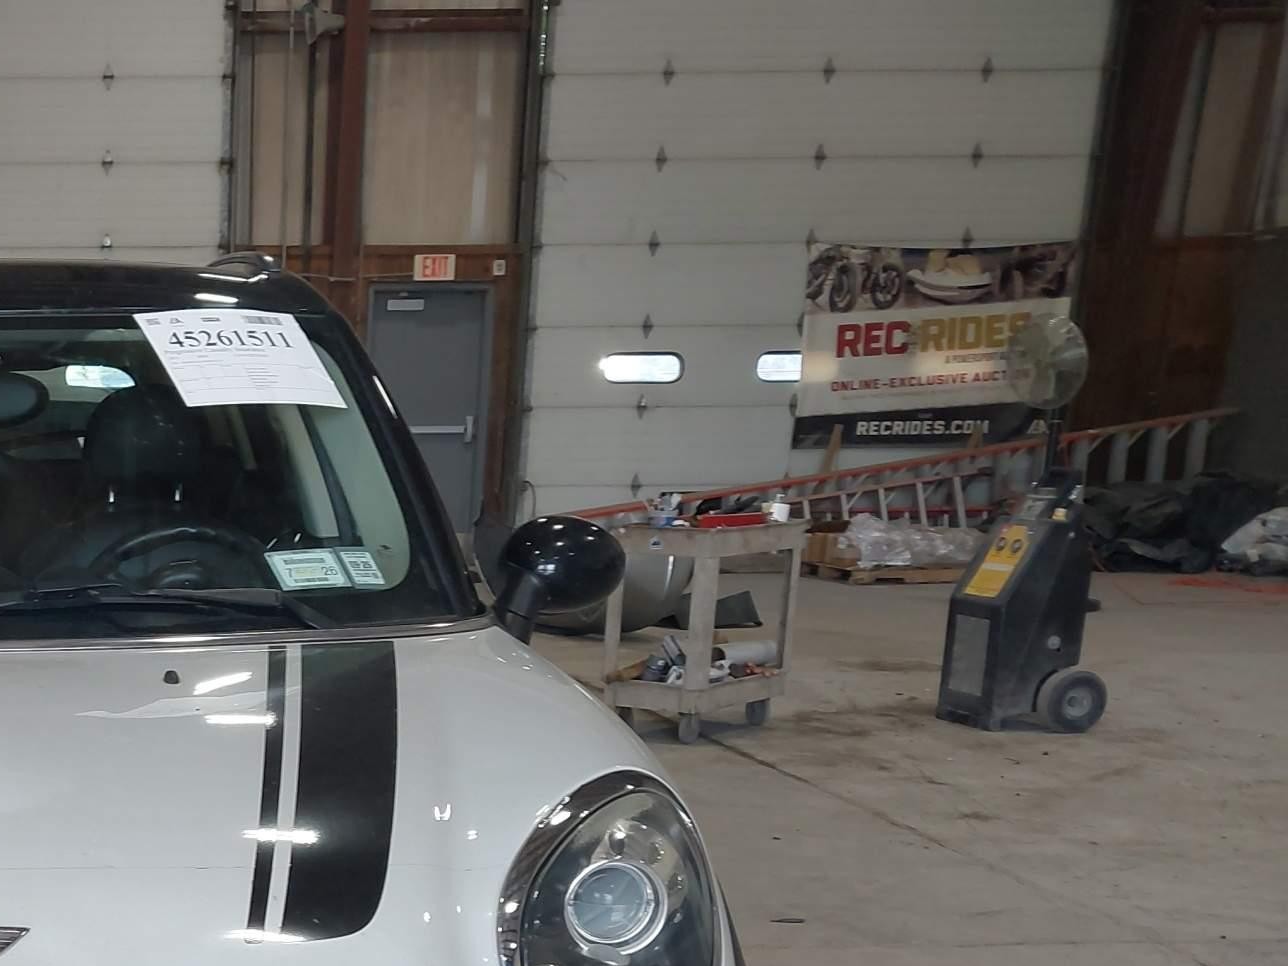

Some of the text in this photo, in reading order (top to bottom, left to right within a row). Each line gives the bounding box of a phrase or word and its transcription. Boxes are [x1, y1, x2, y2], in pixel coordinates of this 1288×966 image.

[422, 255, 449, 278] EXIT
[168, 329, 294, 348] 45261511
[835, 320, 912, 358] REC
[830, 371, 969, 392] ONLINE-EXCLUSIVE
[856, 419, 990, 436] RECRIDES.COM
